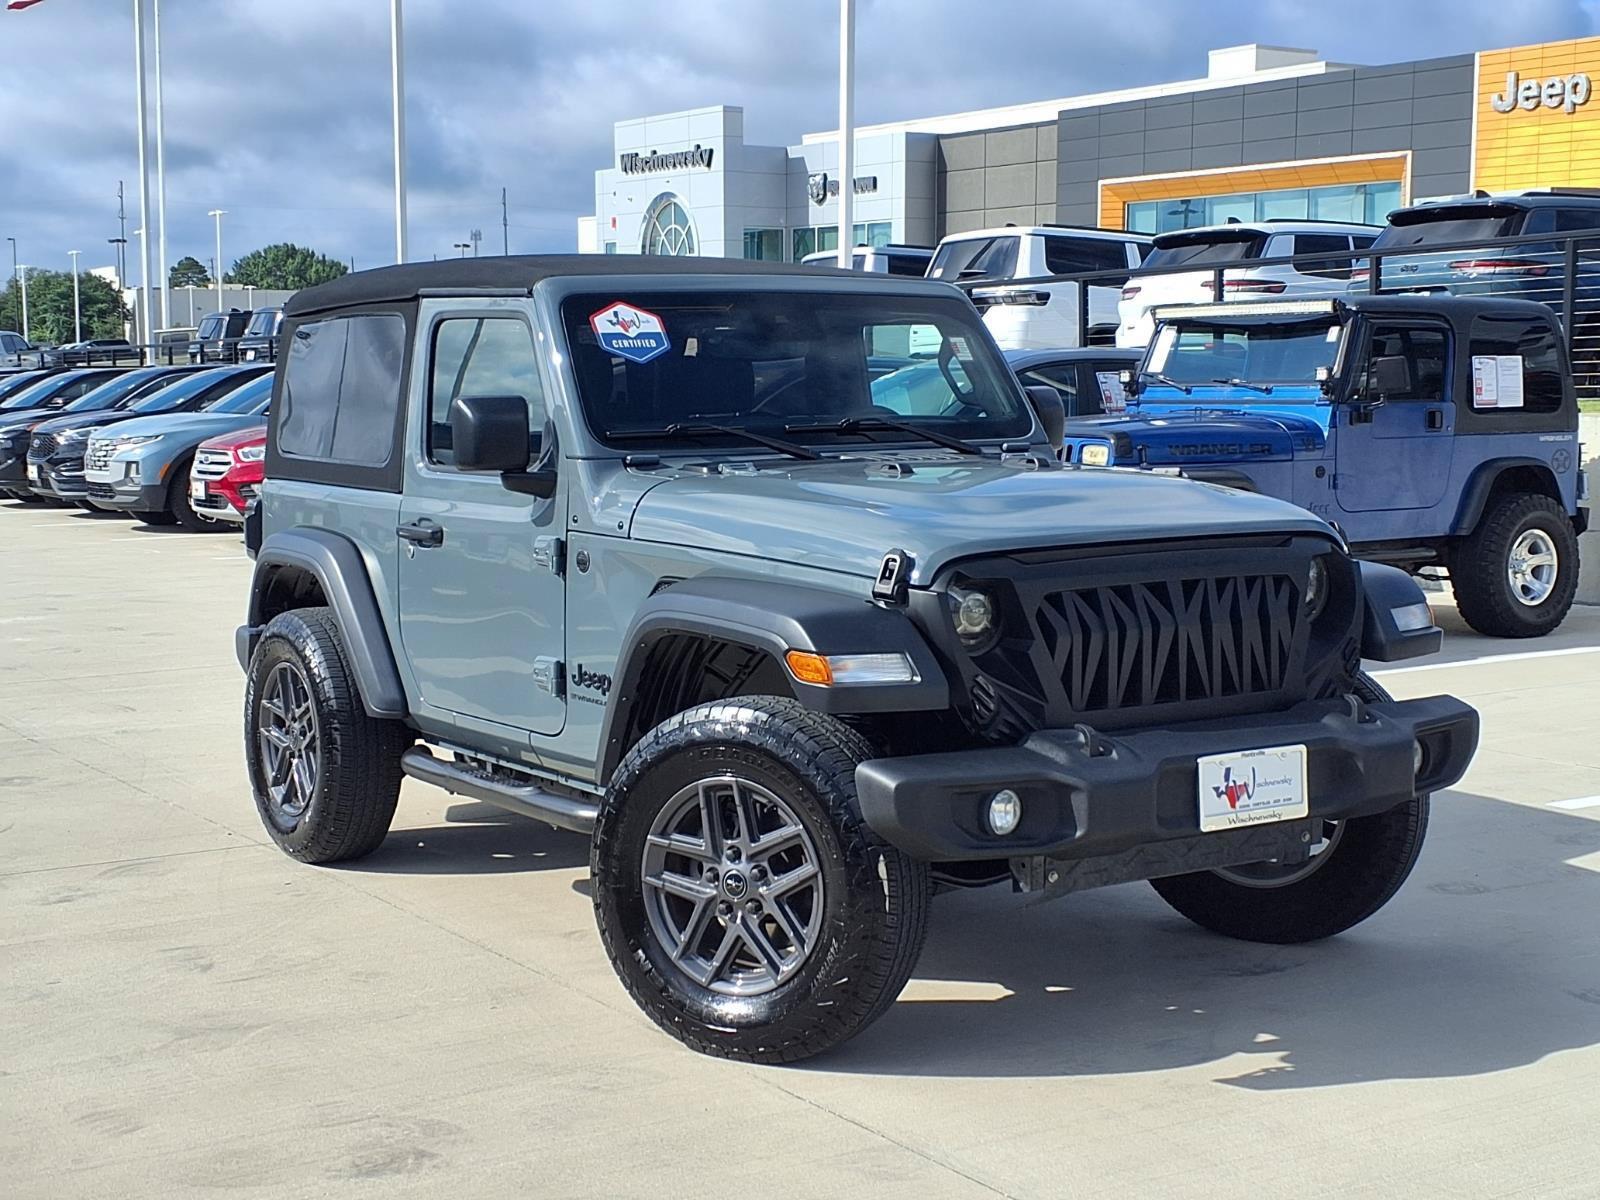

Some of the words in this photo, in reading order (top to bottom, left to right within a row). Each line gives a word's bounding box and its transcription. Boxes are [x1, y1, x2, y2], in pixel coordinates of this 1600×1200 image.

[1491, 71, 1591, 114] Jeep
[620, 144, 714, 175] Wischnewsky
[611, 339, 657, 348] CERTIFIED
[1168, 442, 1272, 456] WRANGLER
[571, 663, 612, 697] Jeep
[1227, 809, 1284, 825] Wischnewsky
